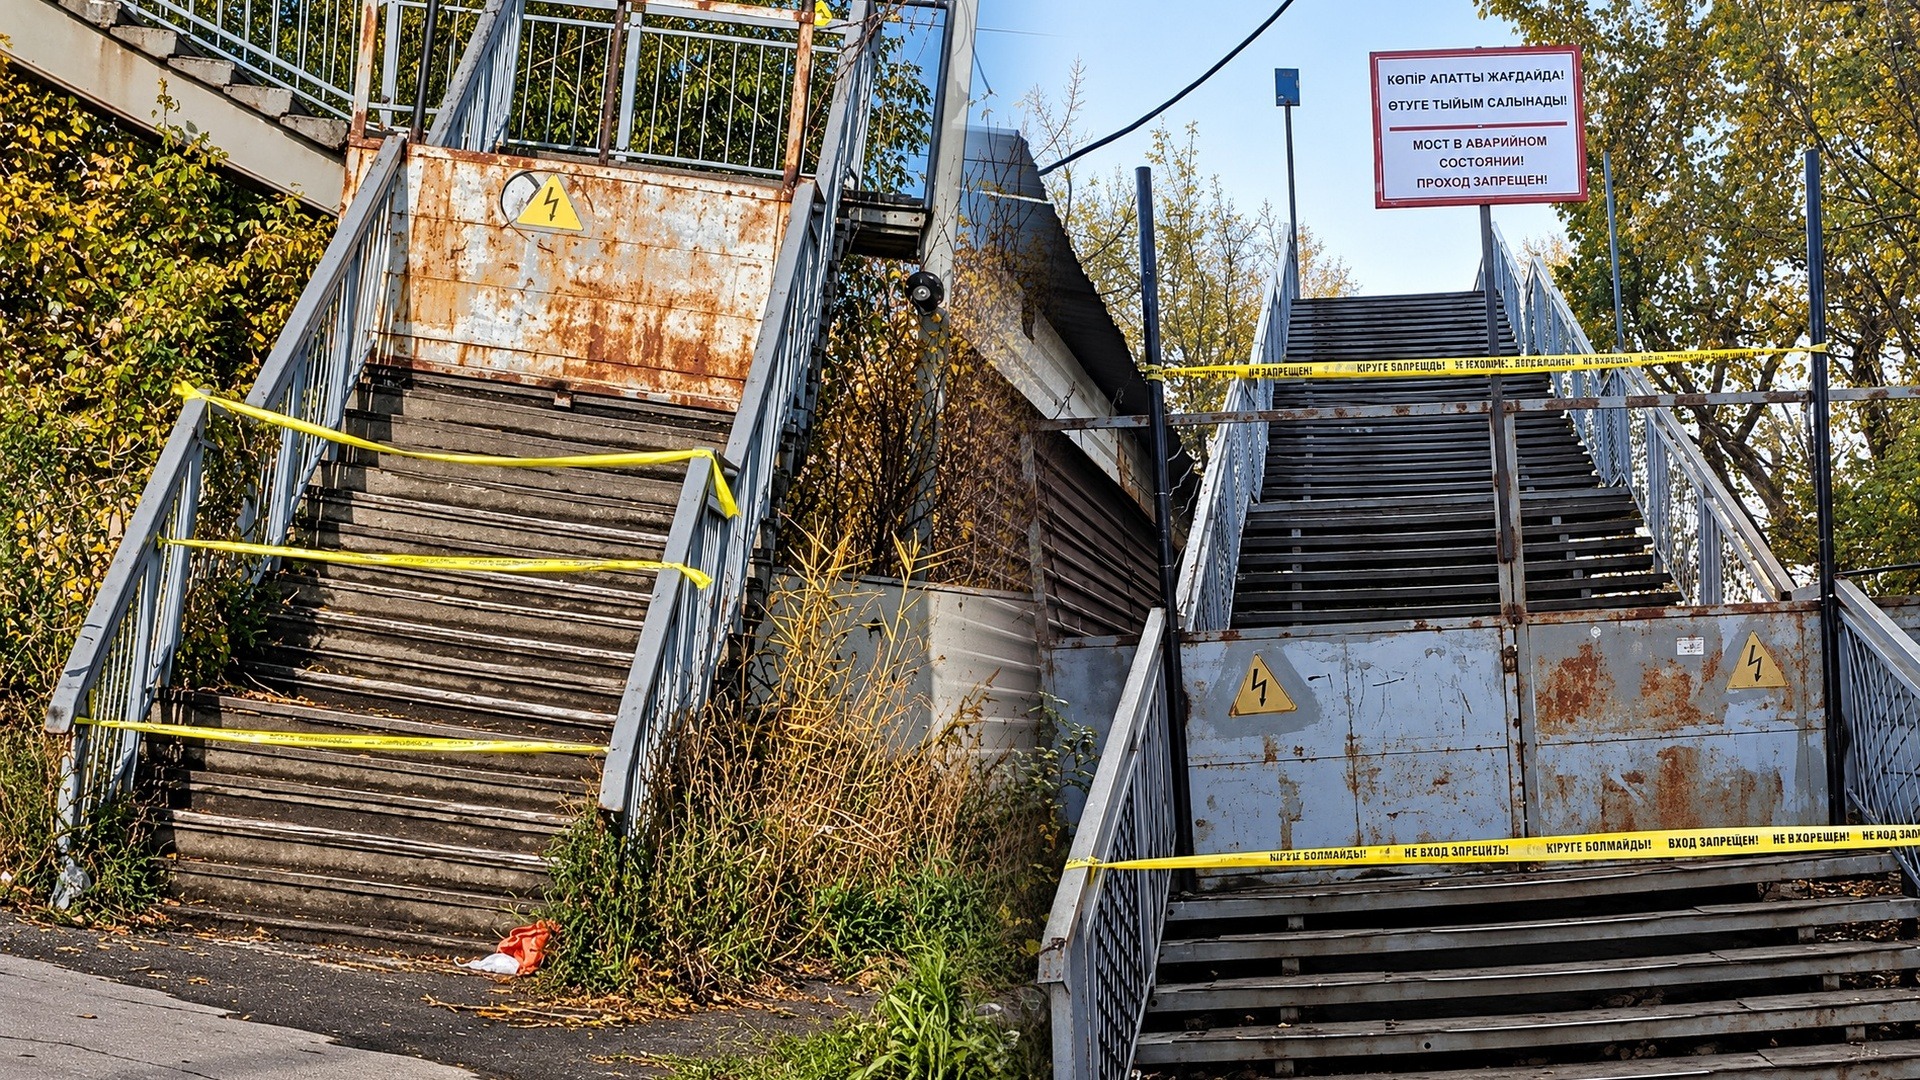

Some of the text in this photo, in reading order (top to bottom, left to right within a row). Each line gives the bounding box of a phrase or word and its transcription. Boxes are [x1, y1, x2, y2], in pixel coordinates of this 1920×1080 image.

[1430, 72, 1484, 84] АПАТТЫ
[1488, 69, 1564, 83] ЖАҒДАЙДА!
[1388, 95, 1567, 111] ӨТУГЕ ТЫЙЫМ САЛЫНАДЫ!
[1413, 134, 1547, 150] МОСТ В АВАРИЙНОМ
[1439, 156, 1524, 168] СОСТОЯНИИ!
[1417, 175, 1548, 189] ПРОХОД ЗАПРЕЩЕН!
[1405, 848, 1417, 857] НЕ
[1421, 846, 1449, 858] ВХОД
[1586, 839, 1651, 851] БОЛМАЙДЫ!
[1668, 837, 1697, 849] ВХОД
[1699, 835, 1759, 847] ЗАПРЕЩЕН!
[1773, 834, 1785, 844] НЕ
[1862, 831, 1875, 840] НЕ
